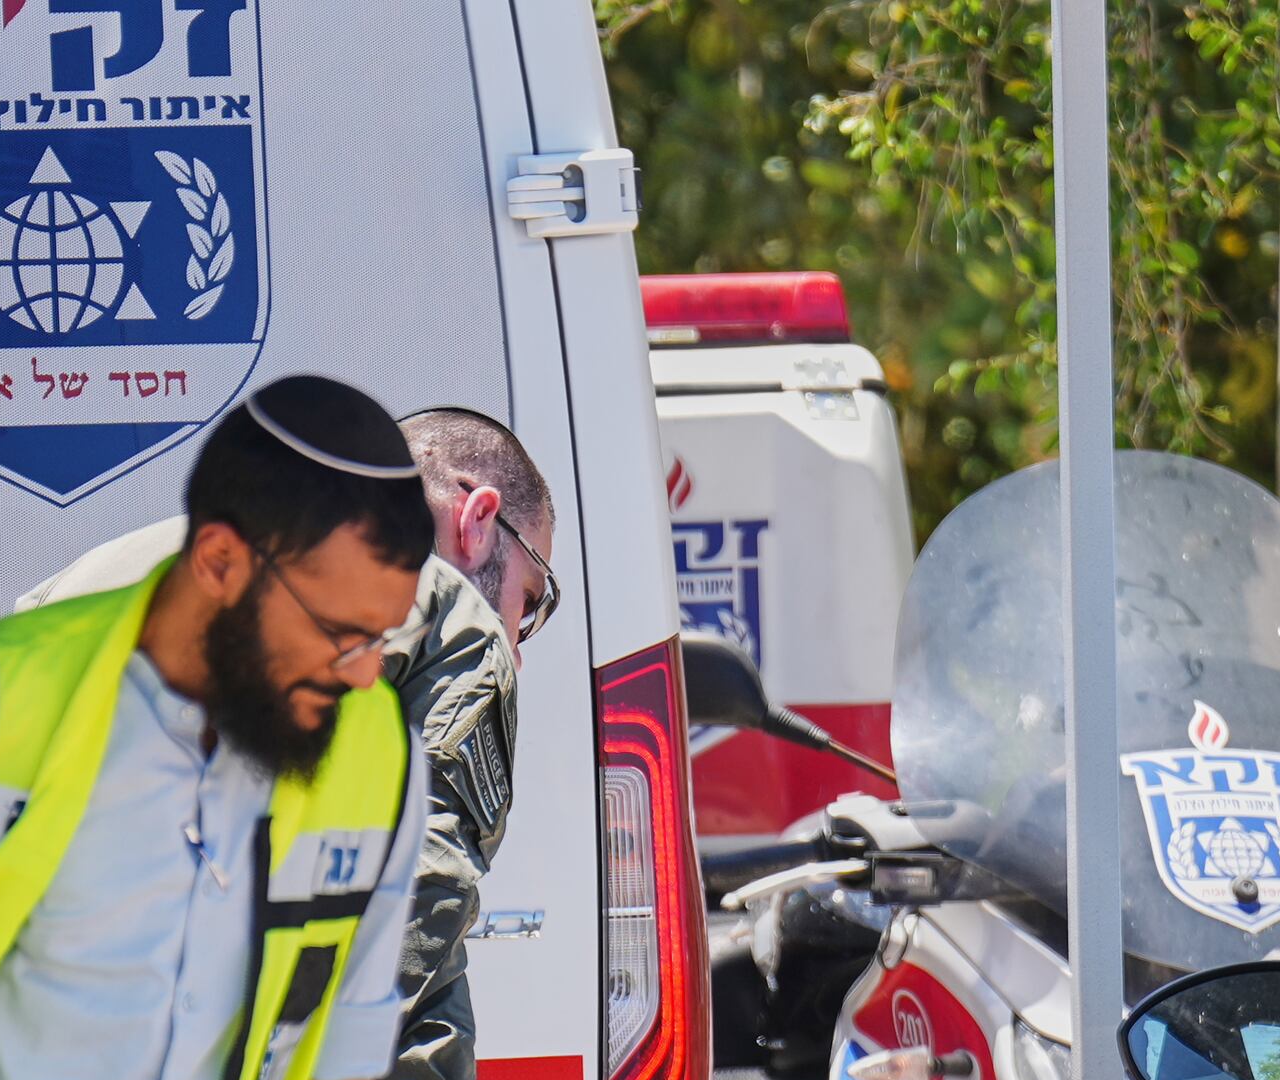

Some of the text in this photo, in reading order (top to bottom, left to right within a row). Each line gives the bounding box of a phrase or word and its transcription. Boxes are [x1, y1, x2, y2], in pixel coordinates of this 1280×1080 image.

[120, 95, 251, 121] איתור
[30, 356, 89, 400] של
[108, 370, 187, 398] חסד
[672, 519, 769, 574] זק
[483, 723, 503, 780] POLICE
[898, 1011, 925, 1045] 201
